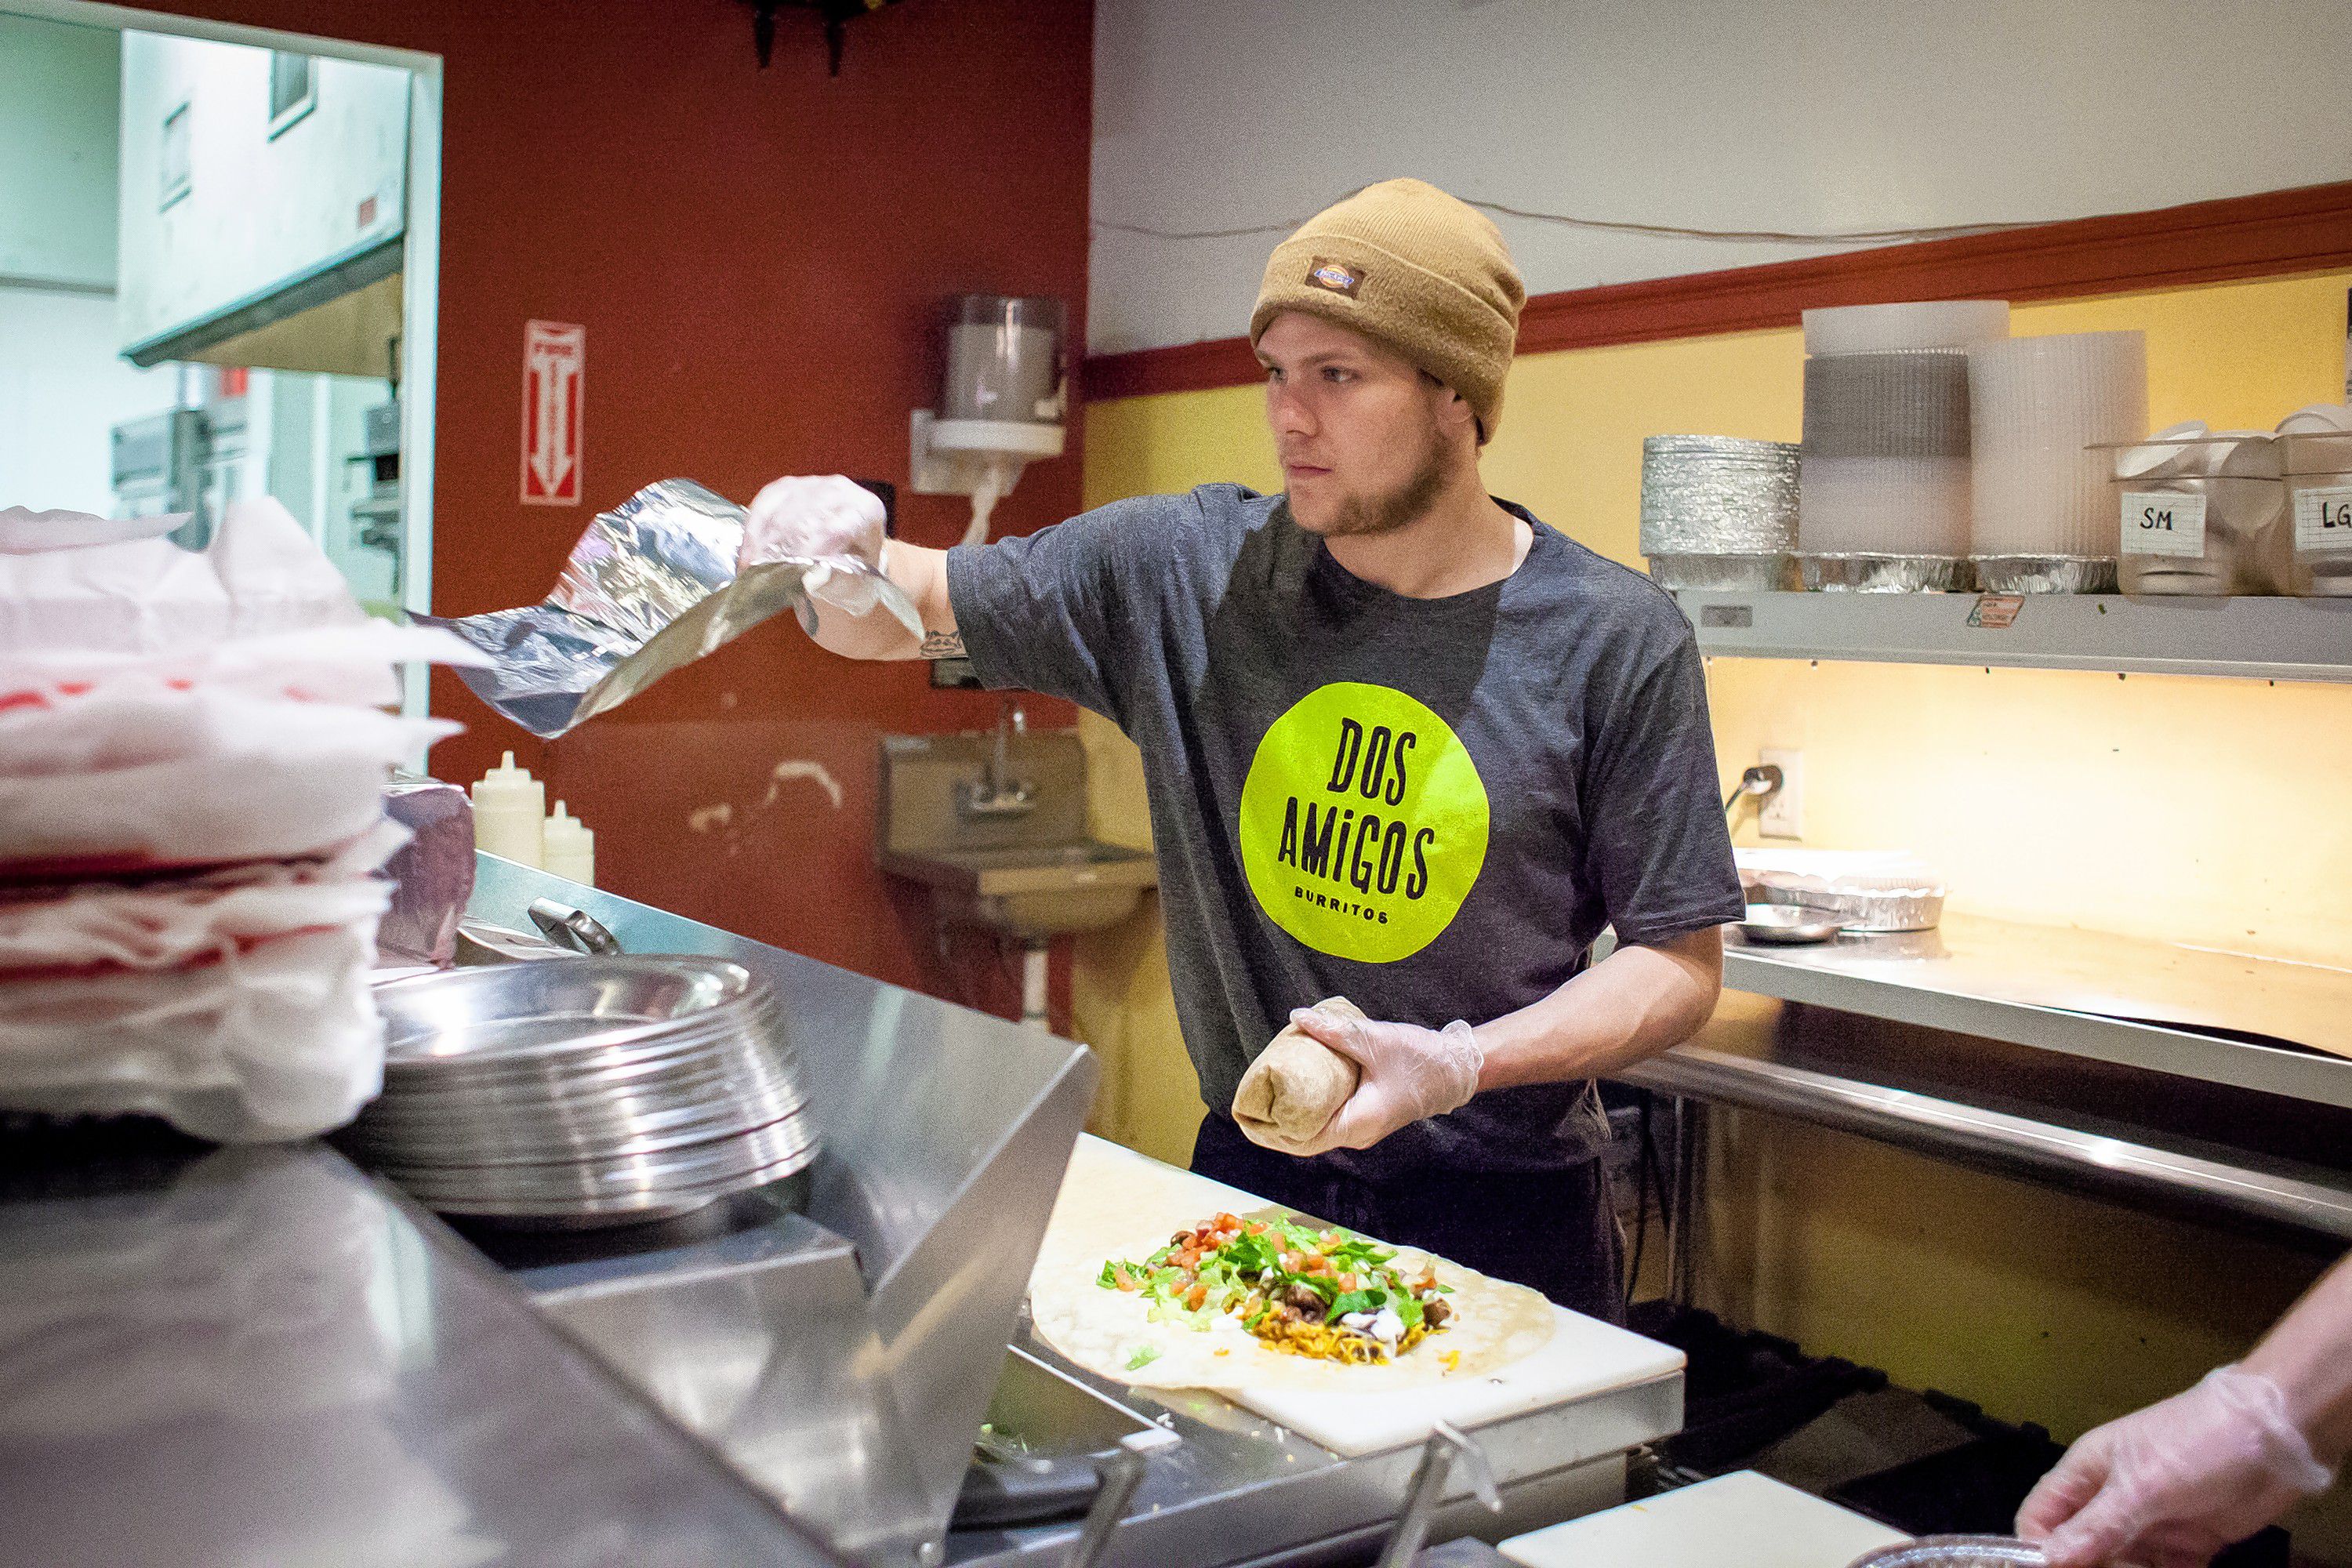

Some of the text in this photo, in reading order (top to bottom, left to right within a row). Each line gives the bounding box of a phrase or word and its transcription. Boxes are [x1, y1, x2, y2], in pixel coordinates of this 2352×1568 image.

[2140, 507, 2172, 531] SM
[2321, 501, 2352, 528] LG
[1327, 717, 1416, 806] DOS
[1294, 886, 1388, 924] BURRITOS
